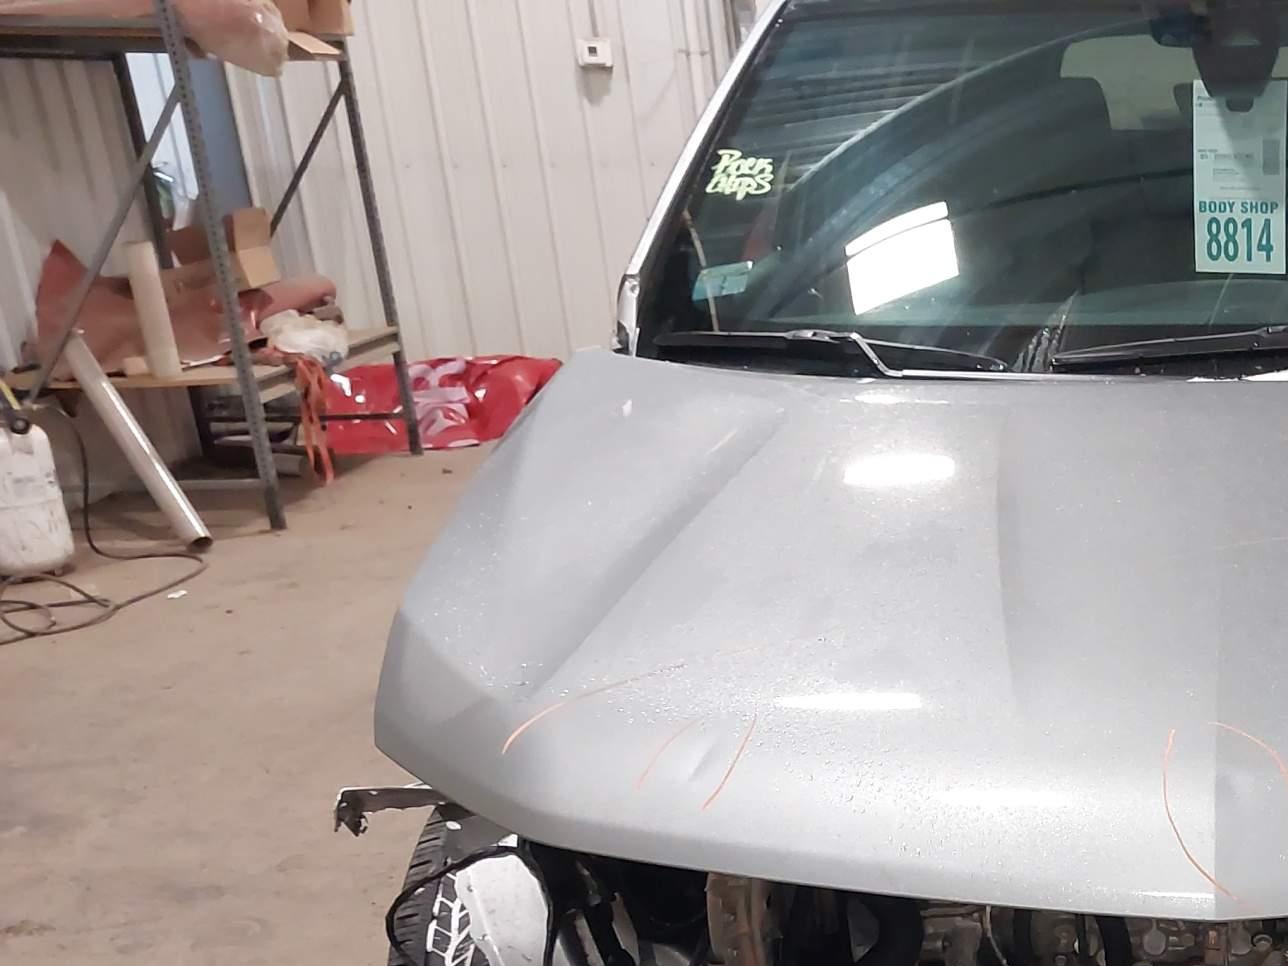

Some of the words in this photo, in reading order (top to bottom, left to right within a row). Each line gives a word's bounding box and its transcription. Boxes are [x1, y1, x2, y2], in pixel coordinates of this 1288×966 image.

[1199, 200, 1236, 213] BODY
[1240, 201, 1279, 214] SHOP
[1206, 217, 1274, 262] 8814
